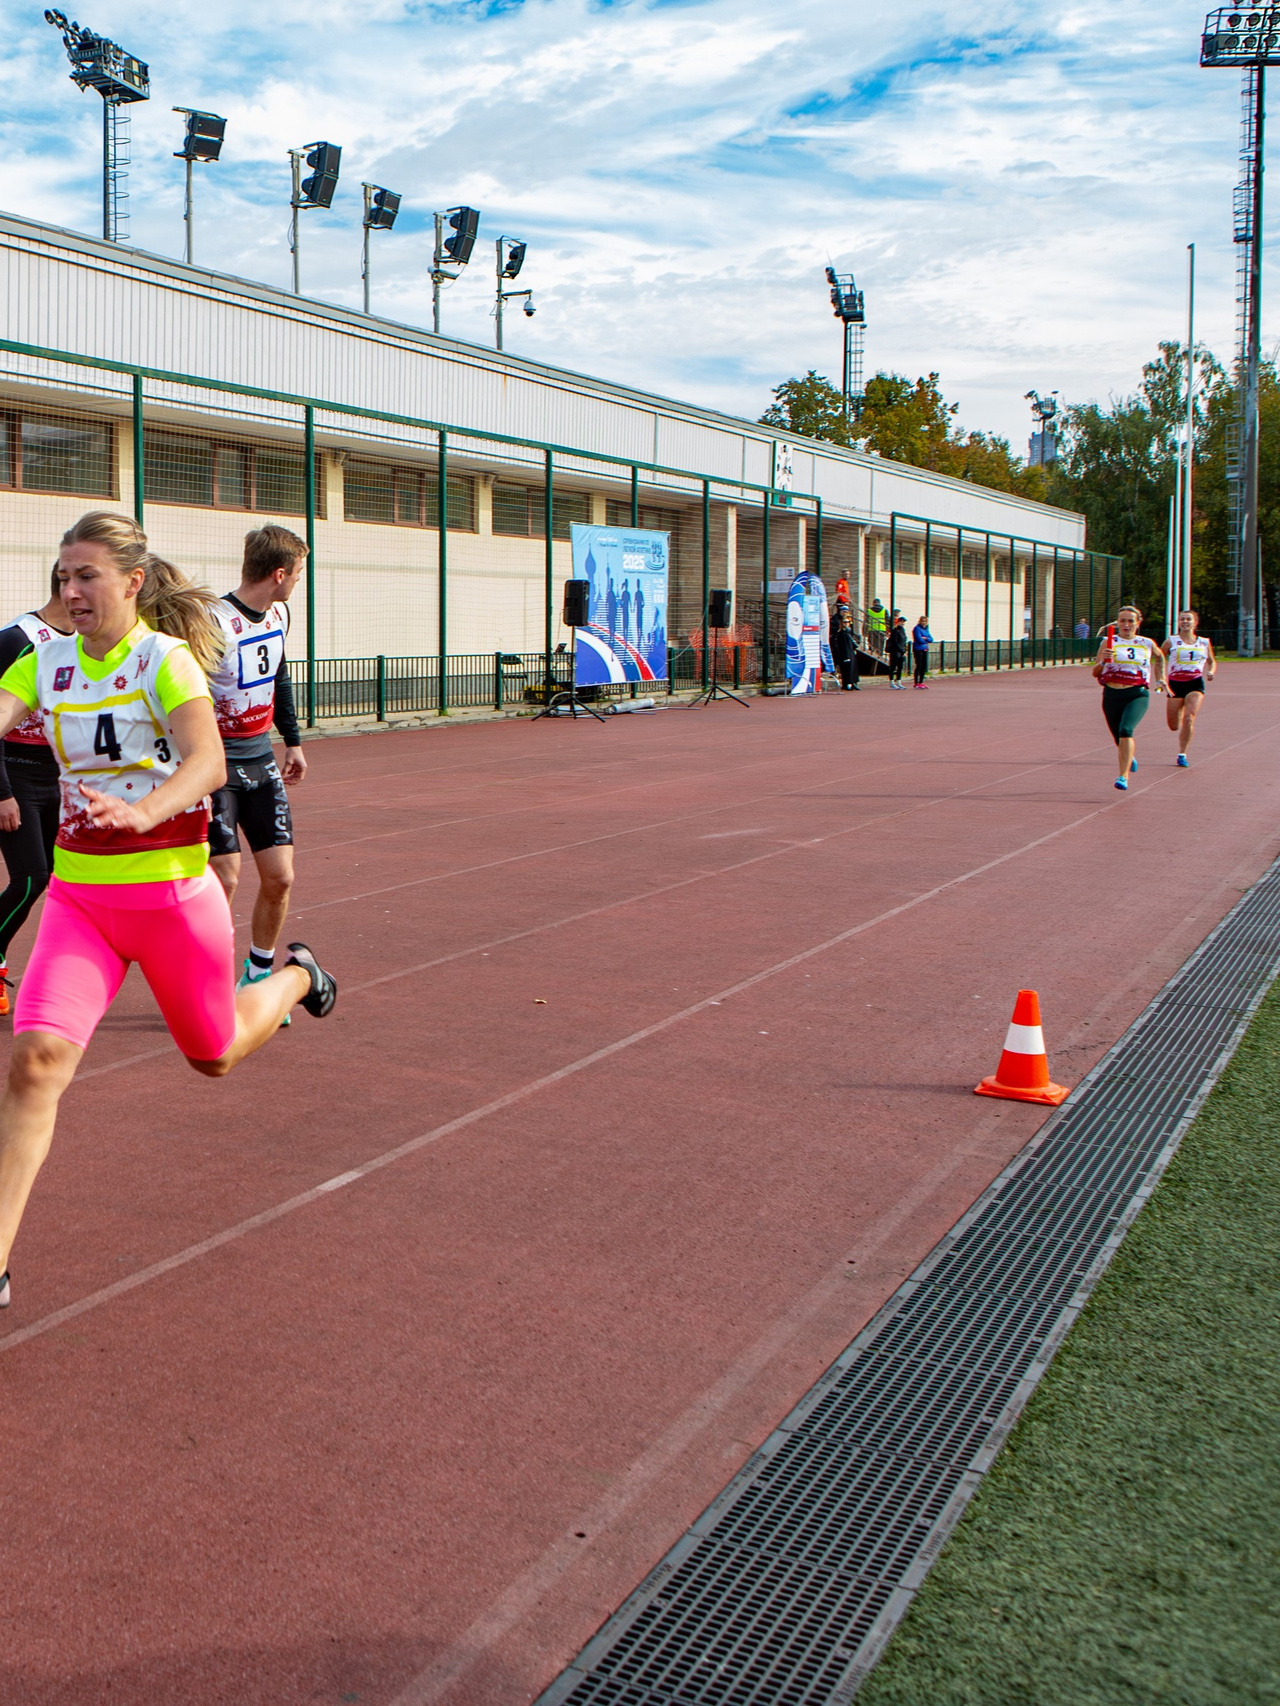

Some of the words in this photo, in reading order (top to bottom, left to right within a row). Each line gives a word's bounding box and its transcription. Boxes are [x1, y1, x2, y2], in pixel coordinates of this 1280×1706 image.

[623, 553, 645, 570] 2025
[257, 645, 269, 675] 3
[1127, 647, 1135, 660] 3
[1188, 651, 1194, 660] 1
[94, 713, 122, 762] 4
[154, 738, 171, 763] 3
